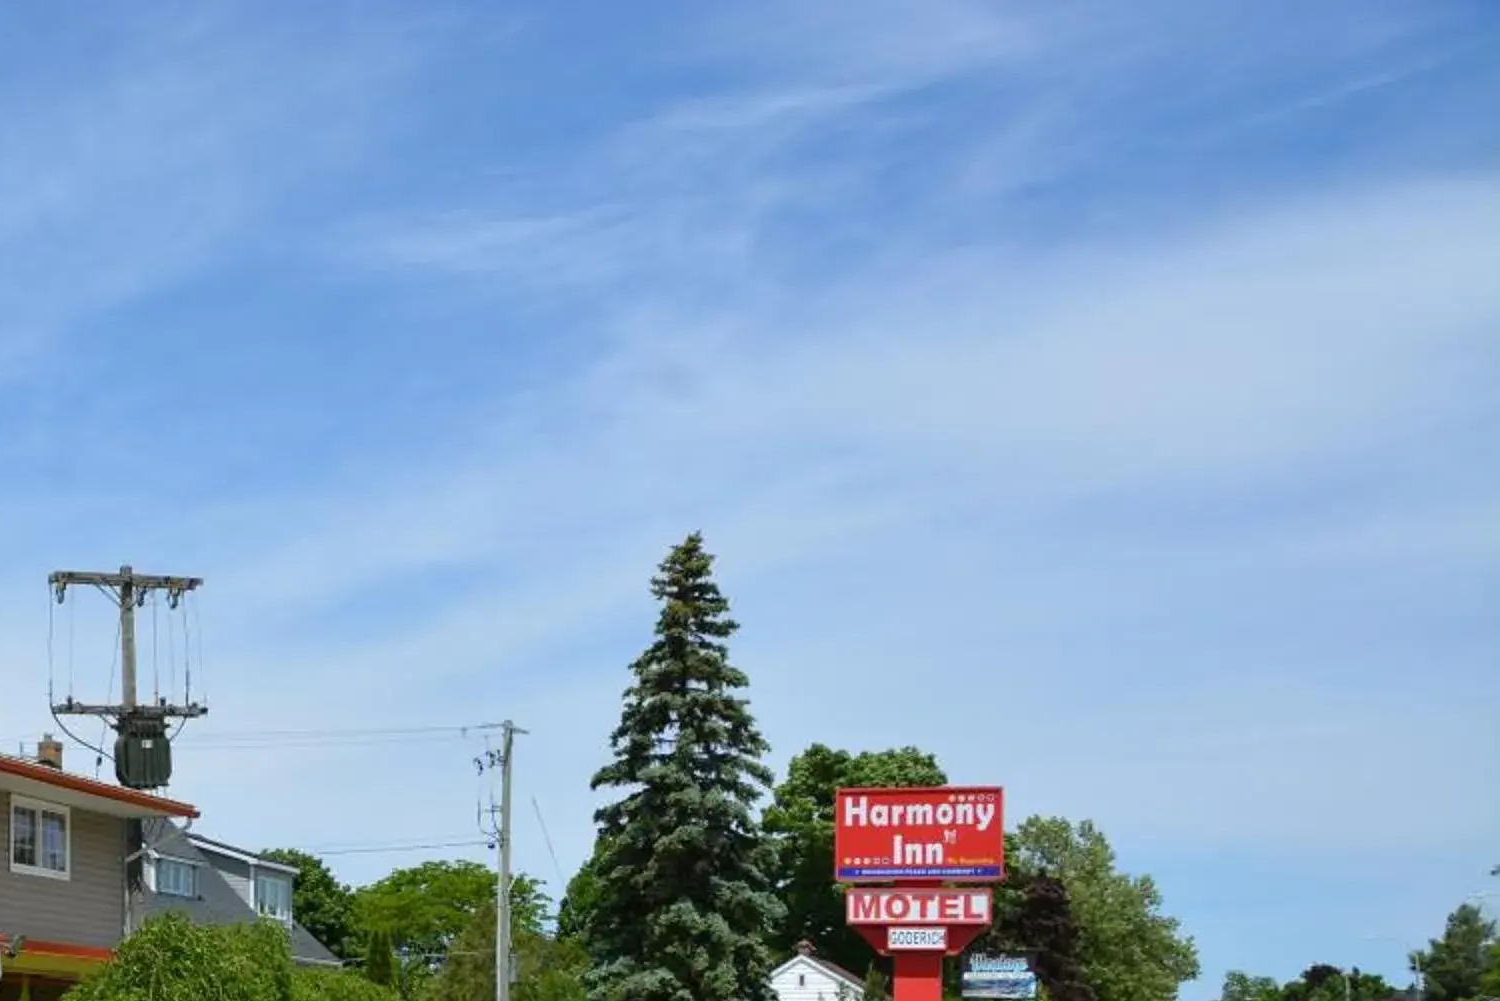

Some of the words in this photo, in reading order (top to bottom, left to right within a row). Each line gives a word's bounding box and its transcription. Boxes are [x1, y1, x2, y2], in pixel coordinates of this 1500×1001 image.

[844, 796, 995, 831] Harmony
[893, 834, 944, 865] Inn
[853, 894, 984, 919] MOTEL
